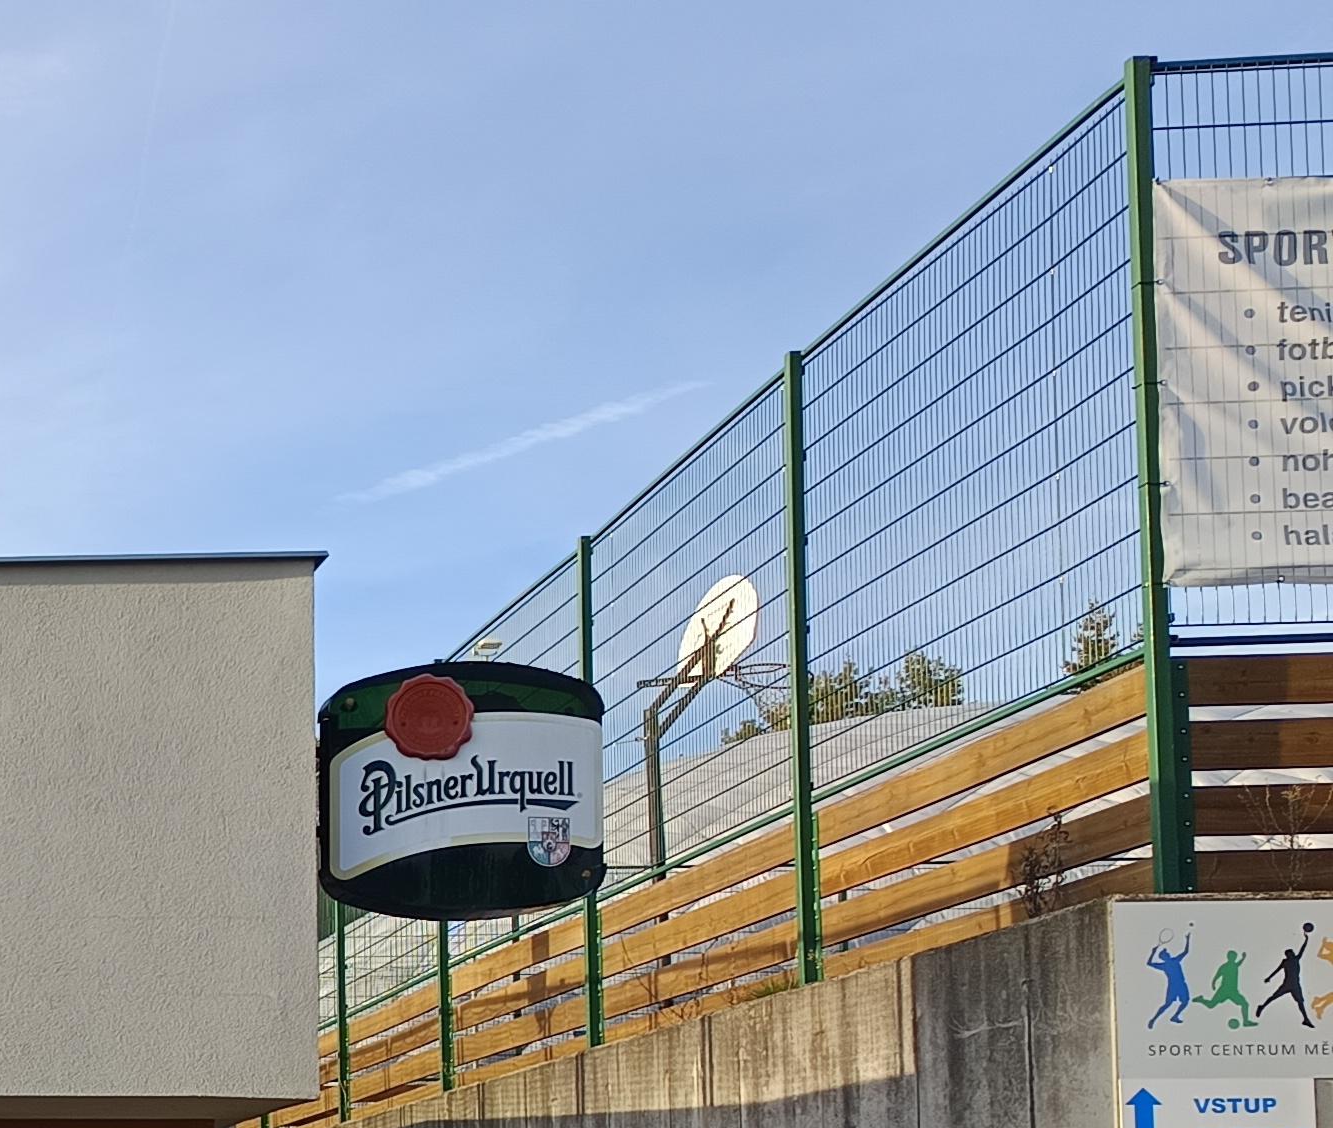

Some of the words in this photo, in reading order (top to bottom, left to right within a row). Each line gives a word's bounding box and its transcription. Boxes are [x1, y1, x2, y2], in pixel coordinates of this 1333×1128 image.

[1218, 229, 1333, 267] SPOR
[1282, 523, 1333, 546] hal
[358, 759, 474, 836] Pilsner
[469, 754, 574, 813] Urquell
[1148, 1043, 1203, 1057] SPORT
[1210, 1043, 1296, 1057] CENTRUM
[1304, 1040, 1333, 1057] MĚ
[1193, 1097, 1277, 1114] VSTUP
